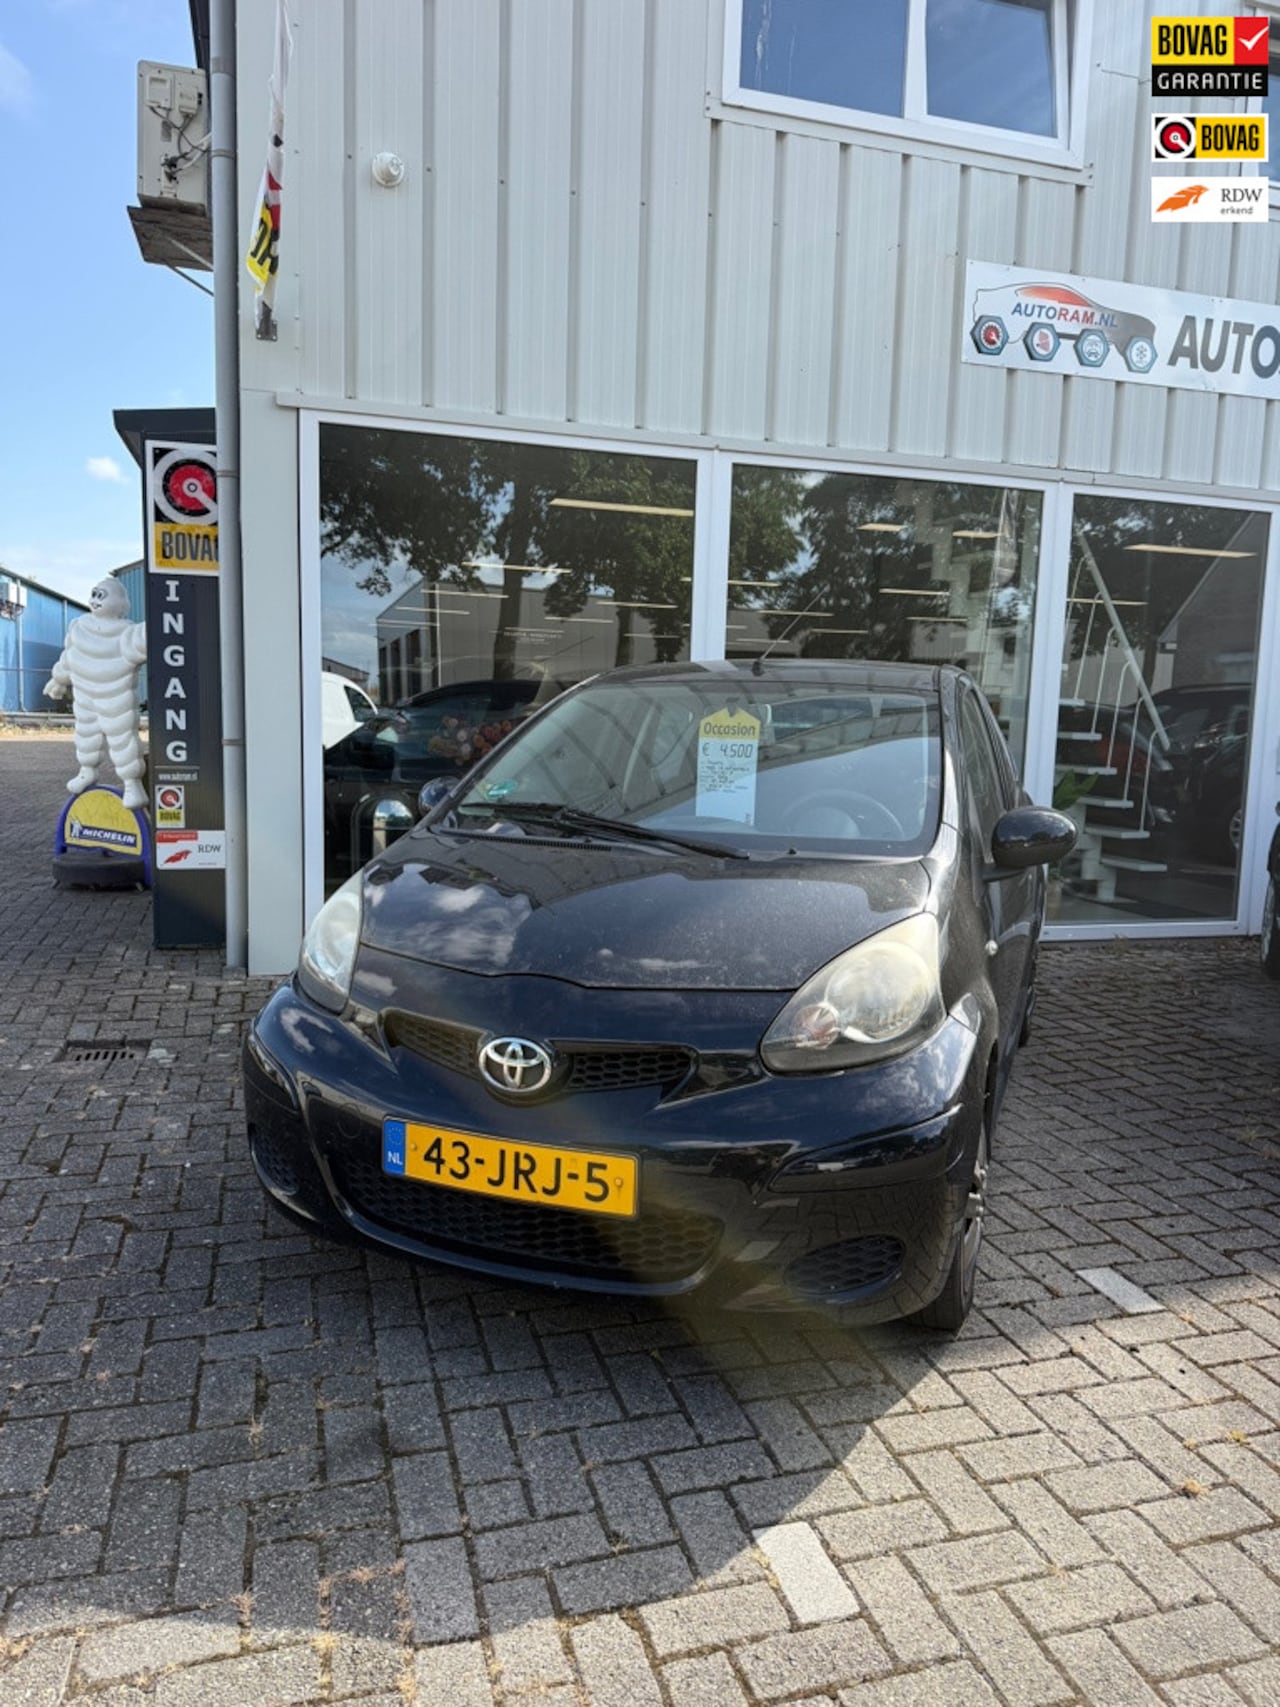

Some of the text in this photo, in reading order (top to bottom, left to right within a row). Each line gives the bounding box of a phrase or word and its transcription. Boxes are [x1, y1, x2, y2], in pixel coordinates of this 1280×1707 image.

[1011, 301, 1118, 329] AUTORAM.NL
[1167, 315, 1280, 379] AUTO
[162, 579, 188, 762] INGANG
[703, 722, 756, 736] Occasion
[82, 829, 135, 843] MICHELIN
[198, 844, 221, 853] RDW
[387, 1151, 403, 1165] NL
[423, 1137, 610, 1203] 43-JRJ-5
